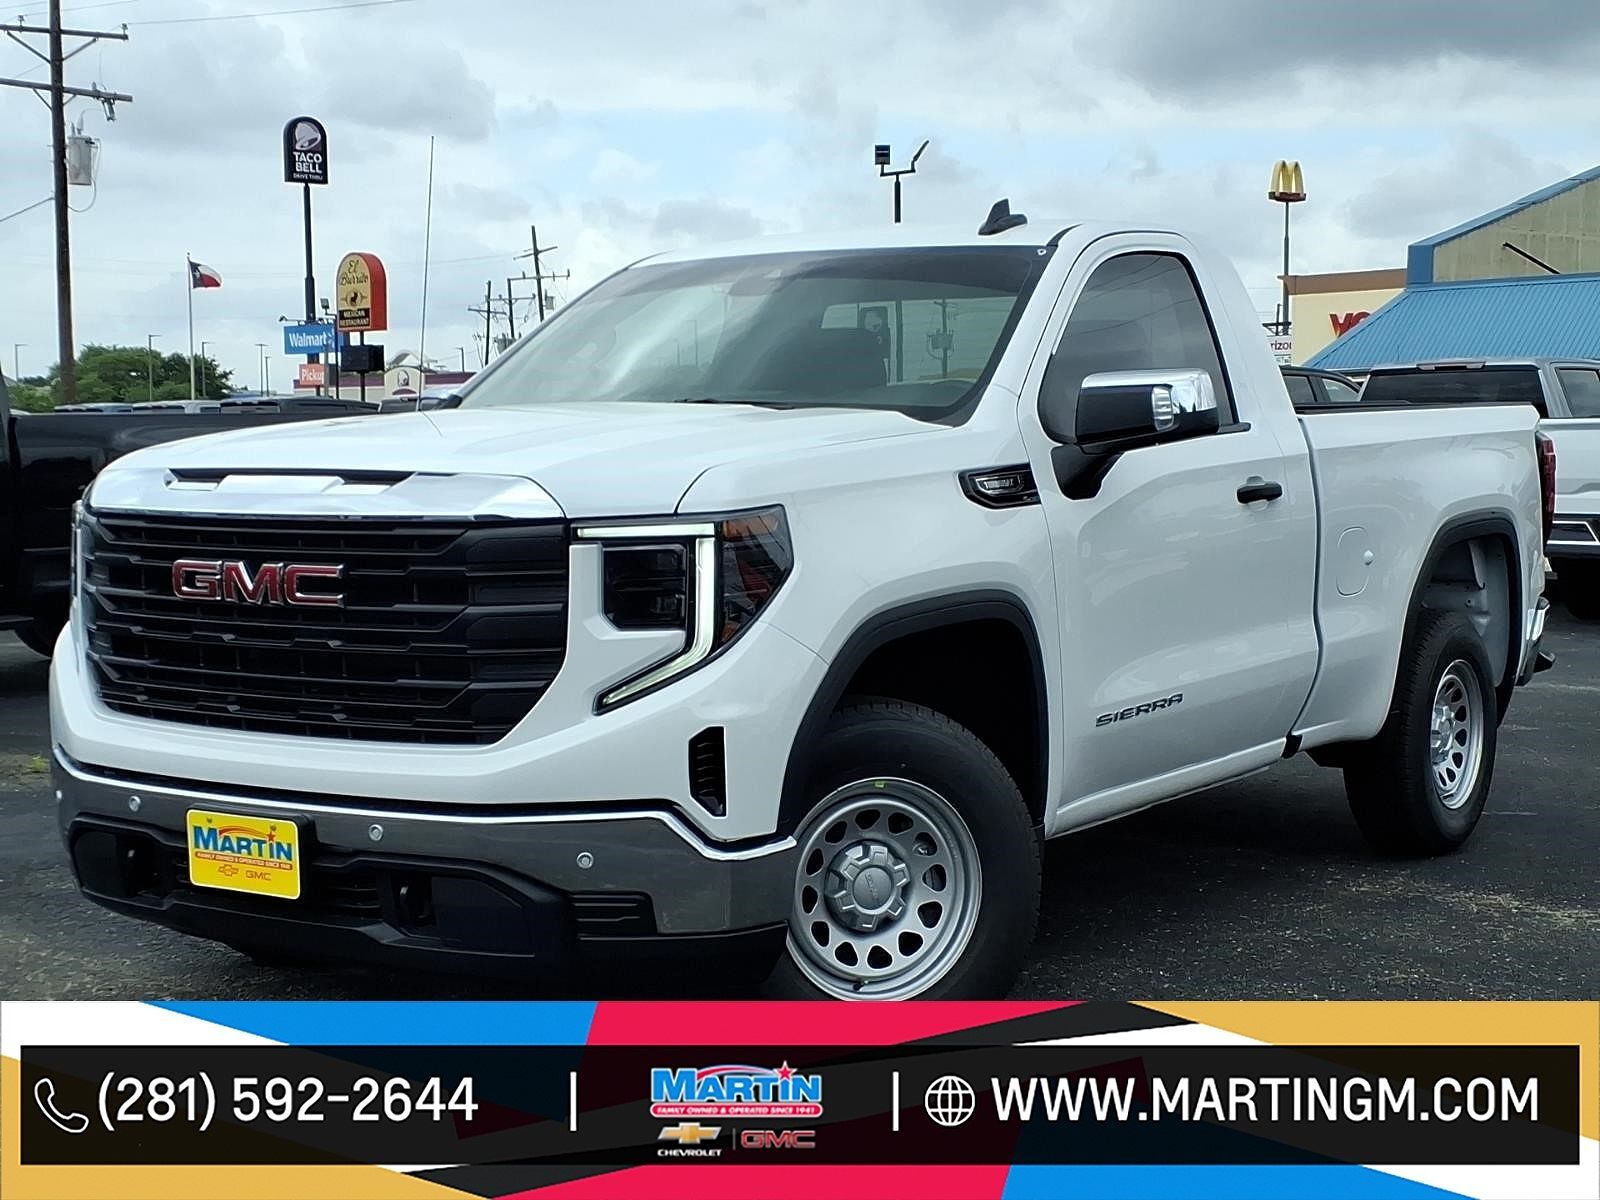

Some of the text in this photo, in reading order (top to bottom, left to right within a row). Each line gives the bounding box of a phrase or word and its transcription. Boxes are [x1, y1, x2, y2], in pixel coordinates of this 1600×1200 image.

[293, 152, 322, 163] TACO
[295, 162, 322, 173] BELL
[289, 332, 327, 347] Walmart
[172, 559, 344, 608] GMC
[1095, 692, 1183, 727] SIERRA
[193, 826, 292, 861] MARTIN
[245, 871, 271, 881] GMC
